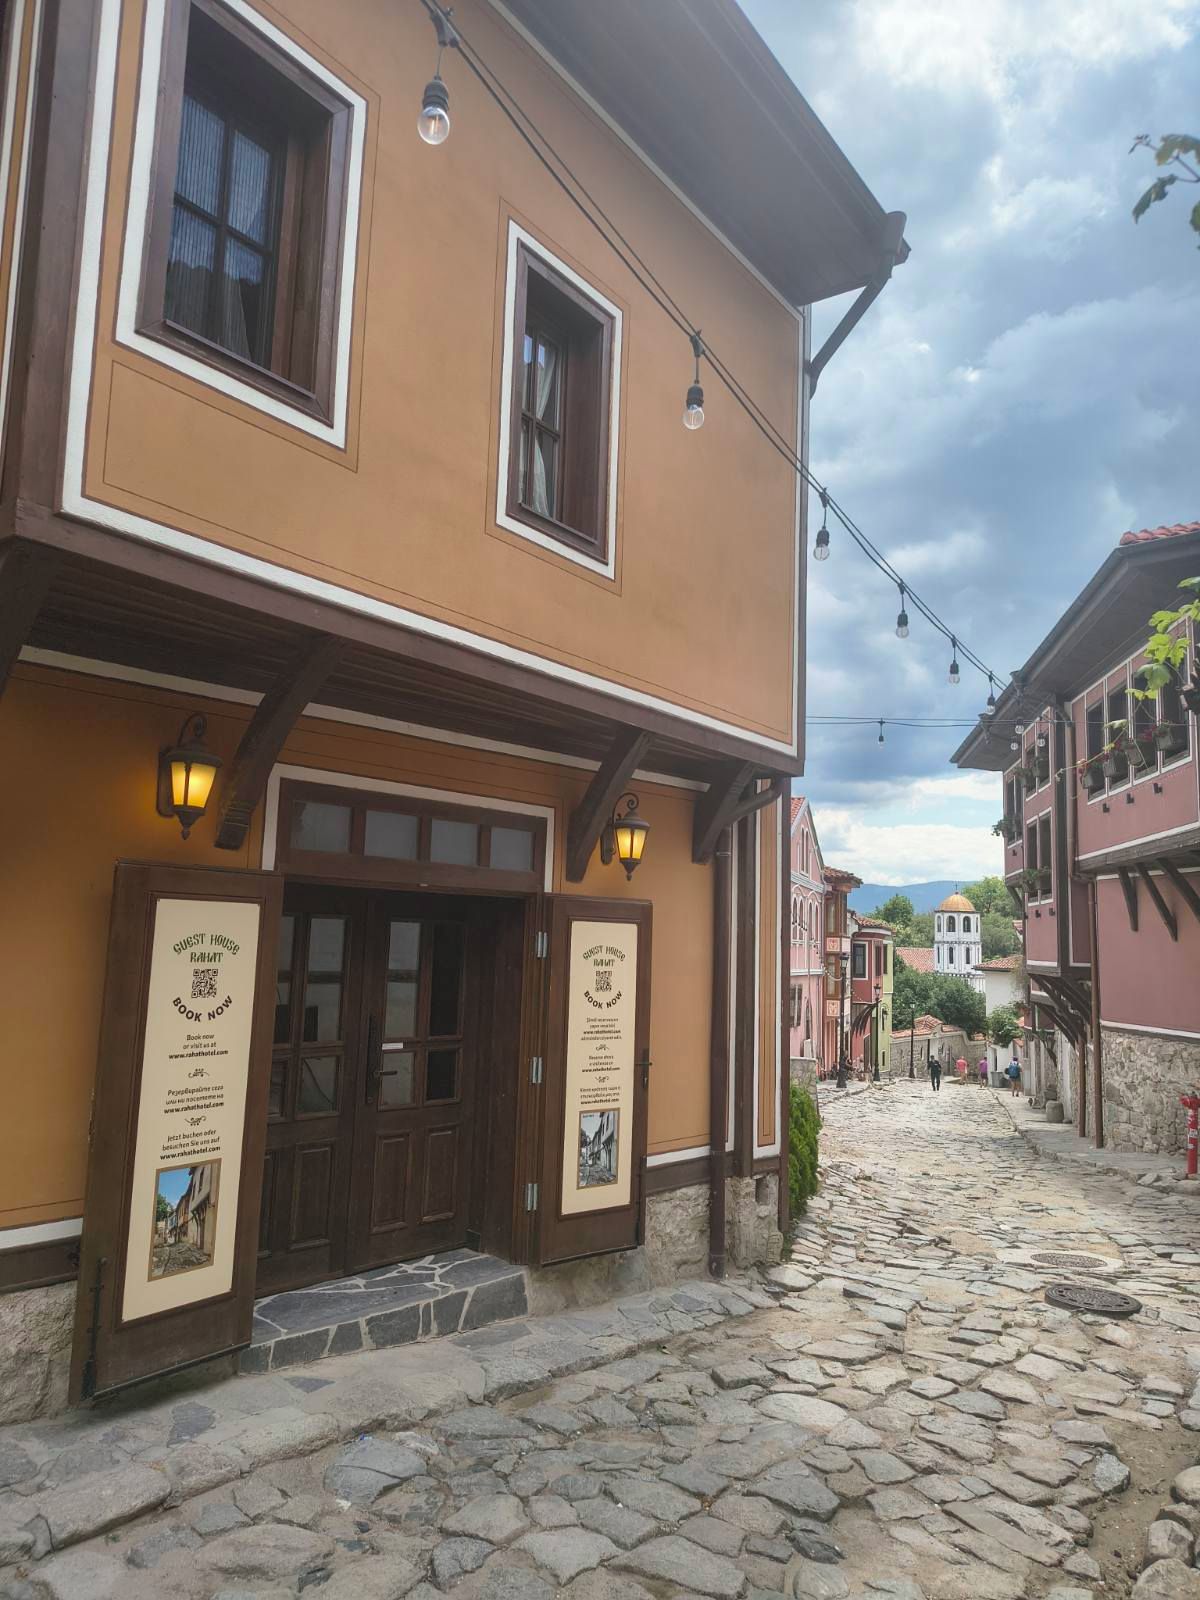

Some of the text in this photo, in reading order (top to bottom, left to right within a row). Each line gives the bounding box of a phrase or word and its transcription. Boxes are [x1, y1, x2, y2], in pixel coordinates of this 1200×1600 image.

[173, 933, 240, 955] GUEST HOUSE
[583, 945, 603, 960] GUEST
[584, 991, 622, 1009] BOOK NOW
[172, 995, 233, 1022] BOOK NOW
[168, 1049, 229, 1060] www.rahathotel.com
[164, 1102, 224, 1115] www.rahathotel.com
[162, 1142, 190, 1152] besuchen
[209, 1136, 220, 1144] auf
[168, 1134, 181, 1143] Jetzt
[182, 1130, 203, 1139] buchen
[160, 1146, 221, 1160] www.rahathotel.com
